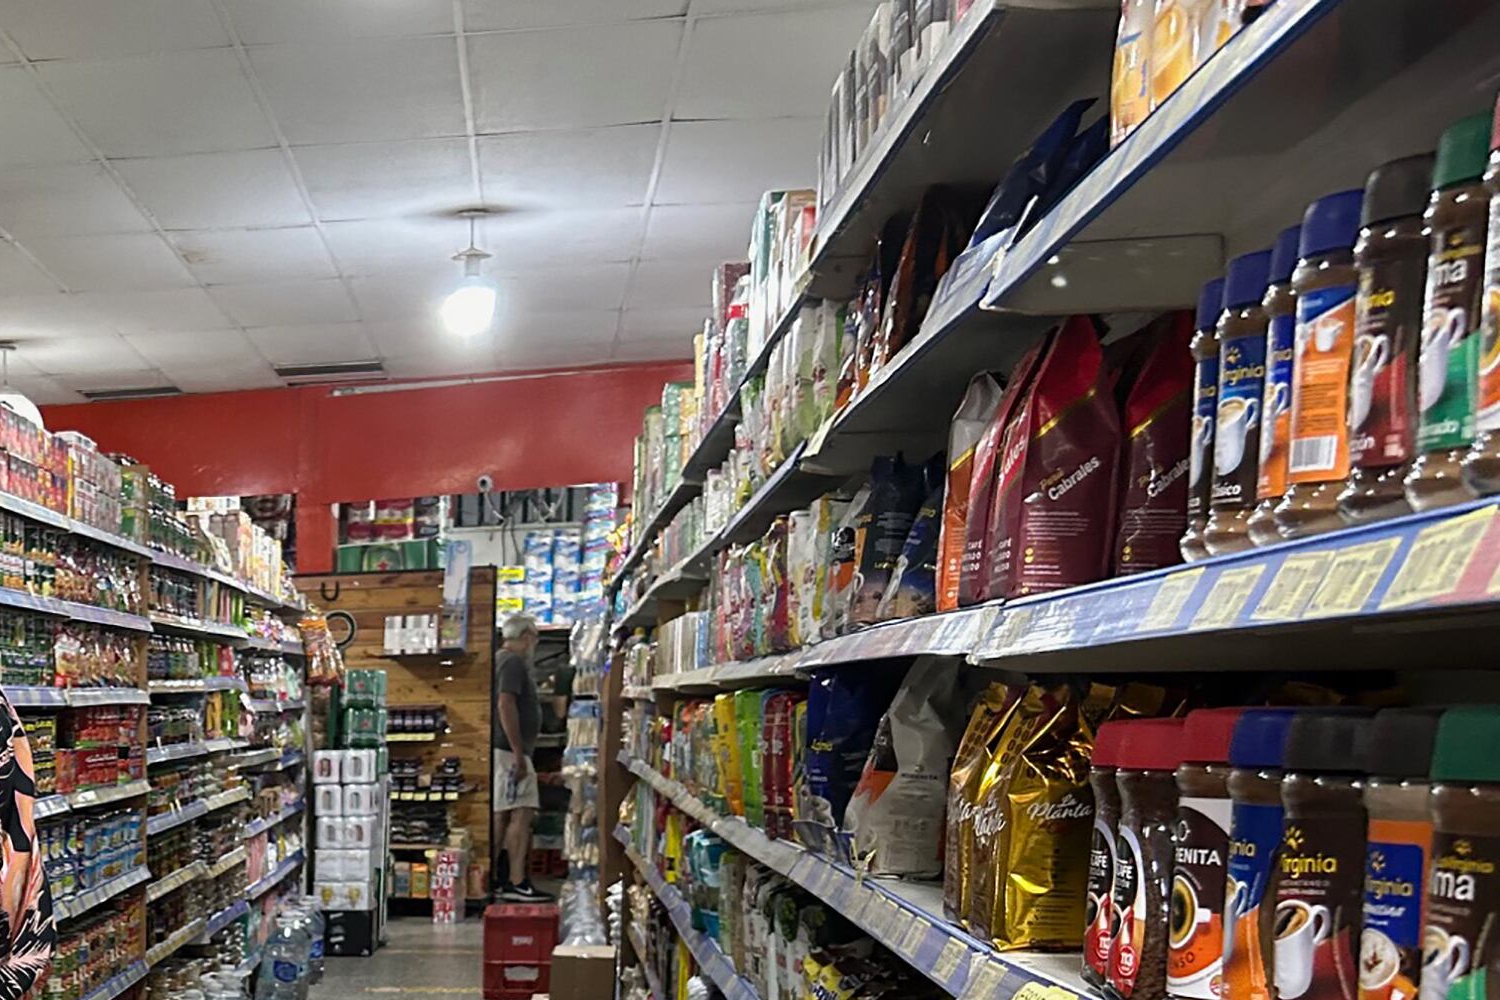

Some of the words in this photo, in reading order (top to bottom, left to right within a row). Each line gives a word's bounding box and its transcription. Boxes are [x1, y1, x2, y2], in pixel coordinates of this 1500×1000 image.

[1048, 456, 1101, 500] Cabrales
[1147, 456, 1191, 499] Cabrale
[1026, 800, 1093, 822] Planta
